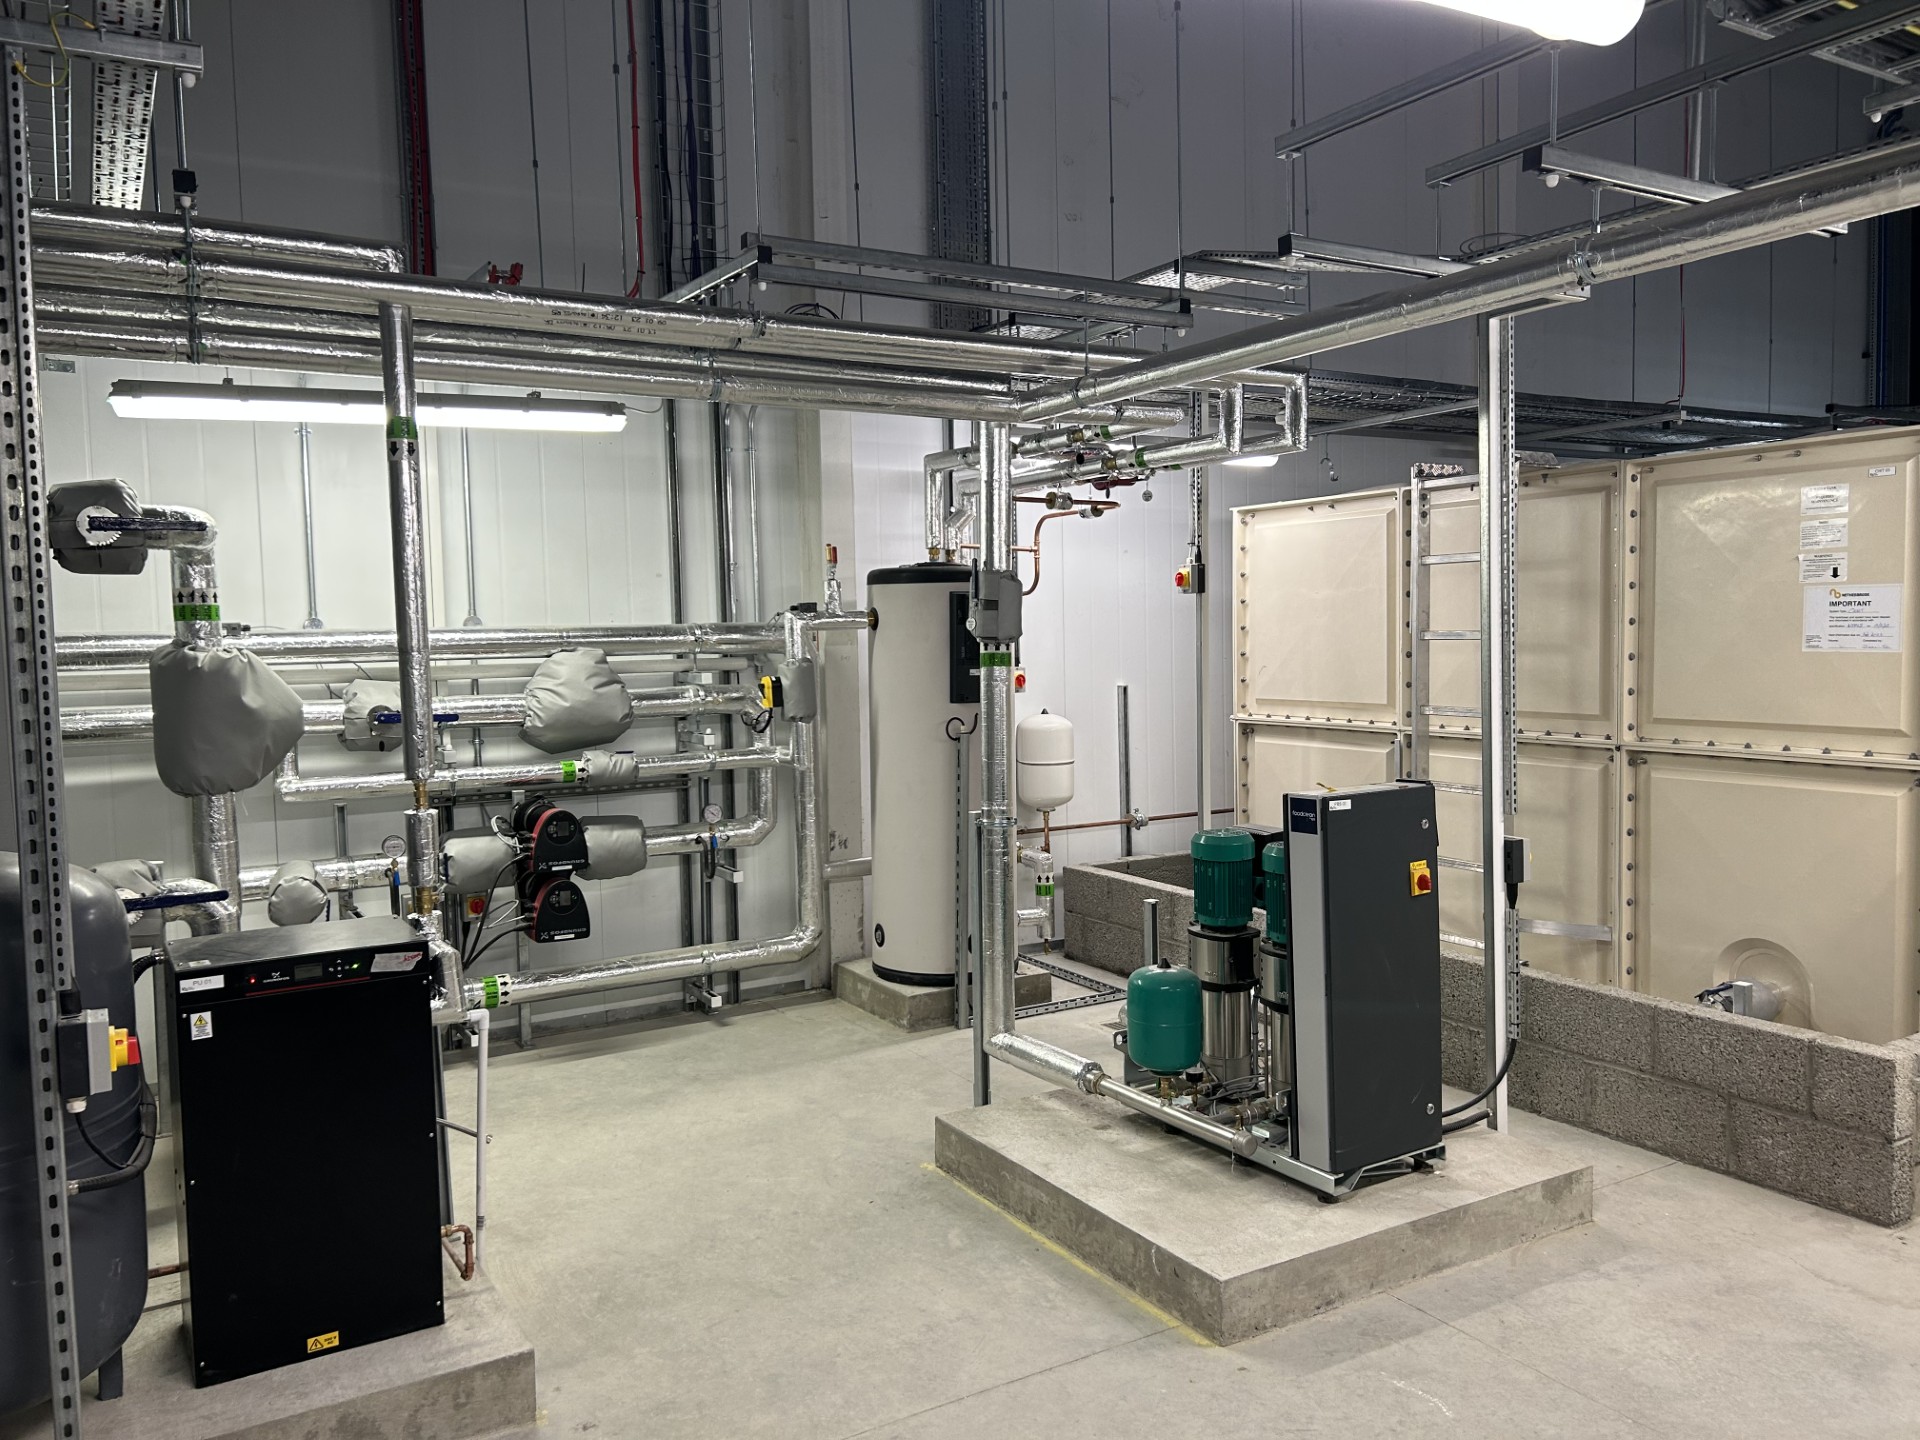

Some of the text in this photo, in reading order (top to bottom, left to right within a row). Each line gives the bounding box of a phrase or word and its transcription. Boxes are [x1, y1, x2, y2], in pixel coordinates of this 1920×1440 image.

[601, 313, 623, 322] 12:34
[631, 315, 641, 323] 23
[549, 927, 587, 935] GRUNDFOS
